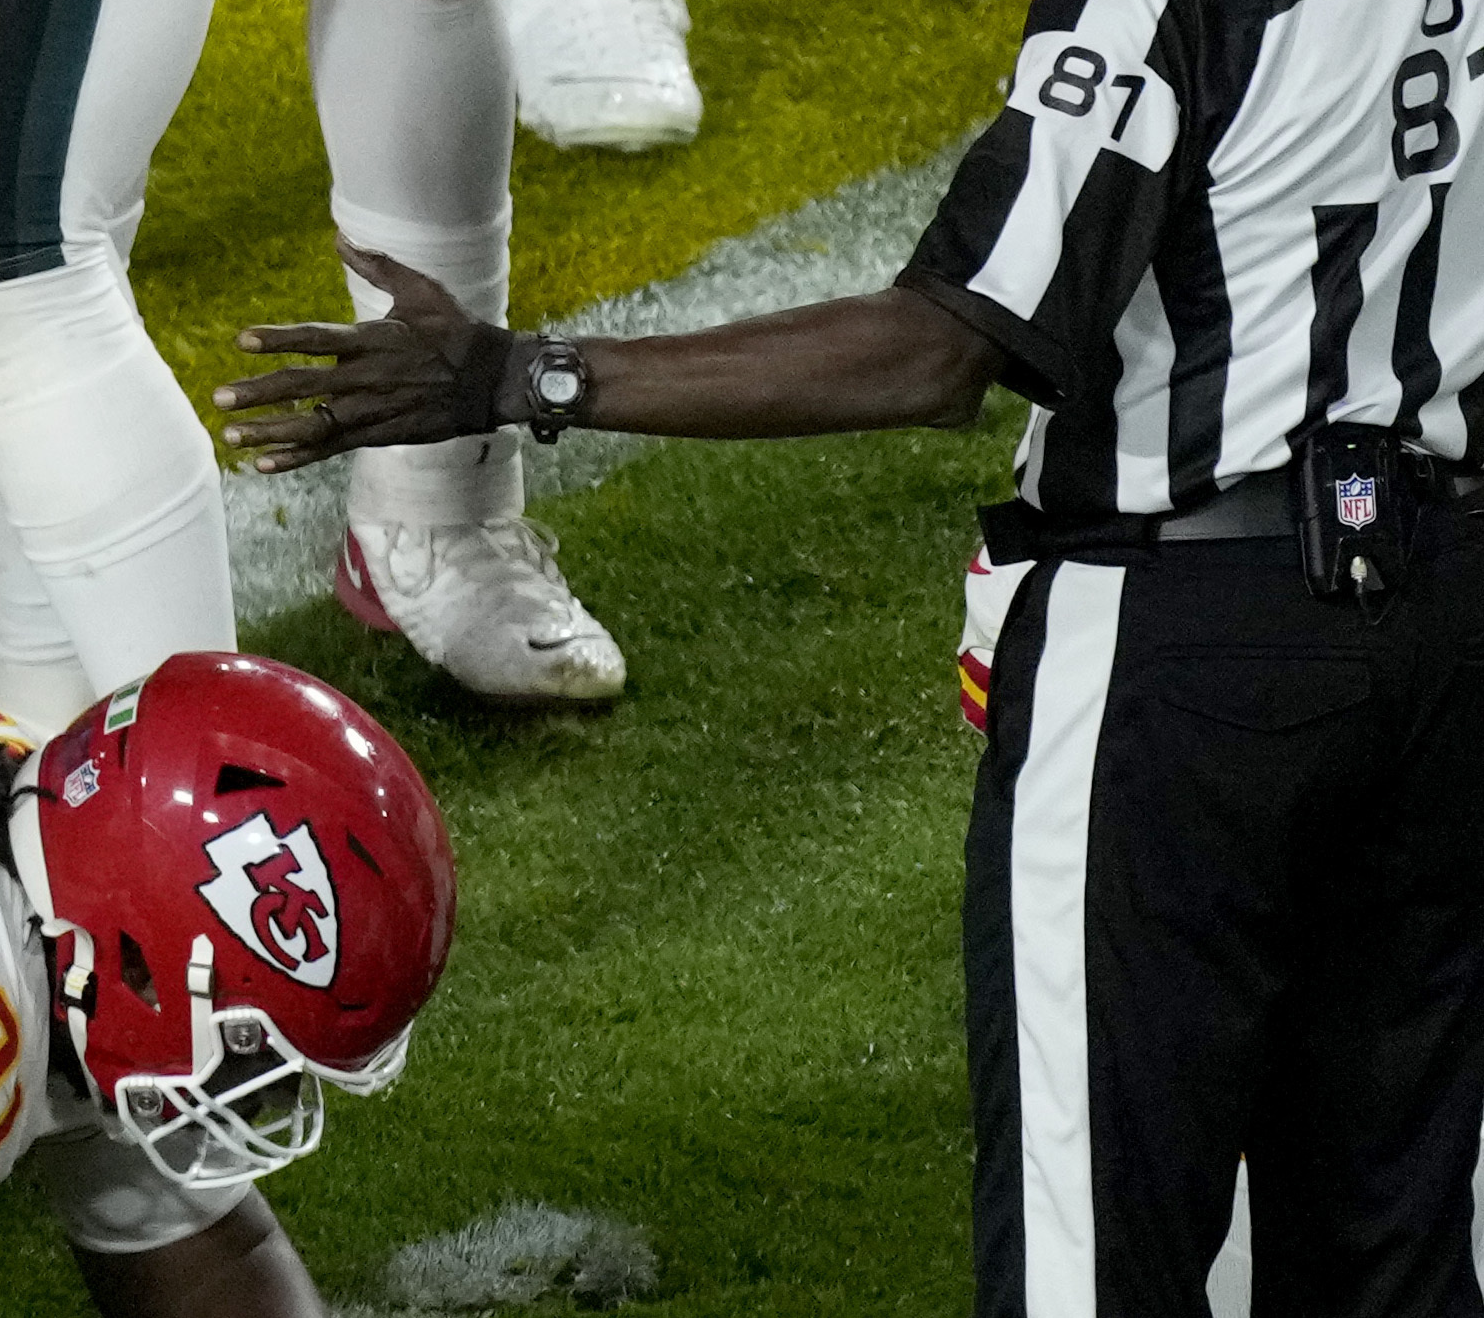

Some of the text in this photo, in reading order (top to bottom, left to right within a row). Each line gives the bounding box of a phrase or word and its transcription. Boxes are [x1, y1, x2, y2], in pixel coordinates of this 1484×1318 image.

[1038, 45, 1147, 143] 81
[1342, 497, 1373, 522] NFL
[241, 842, 331, 973] KC
